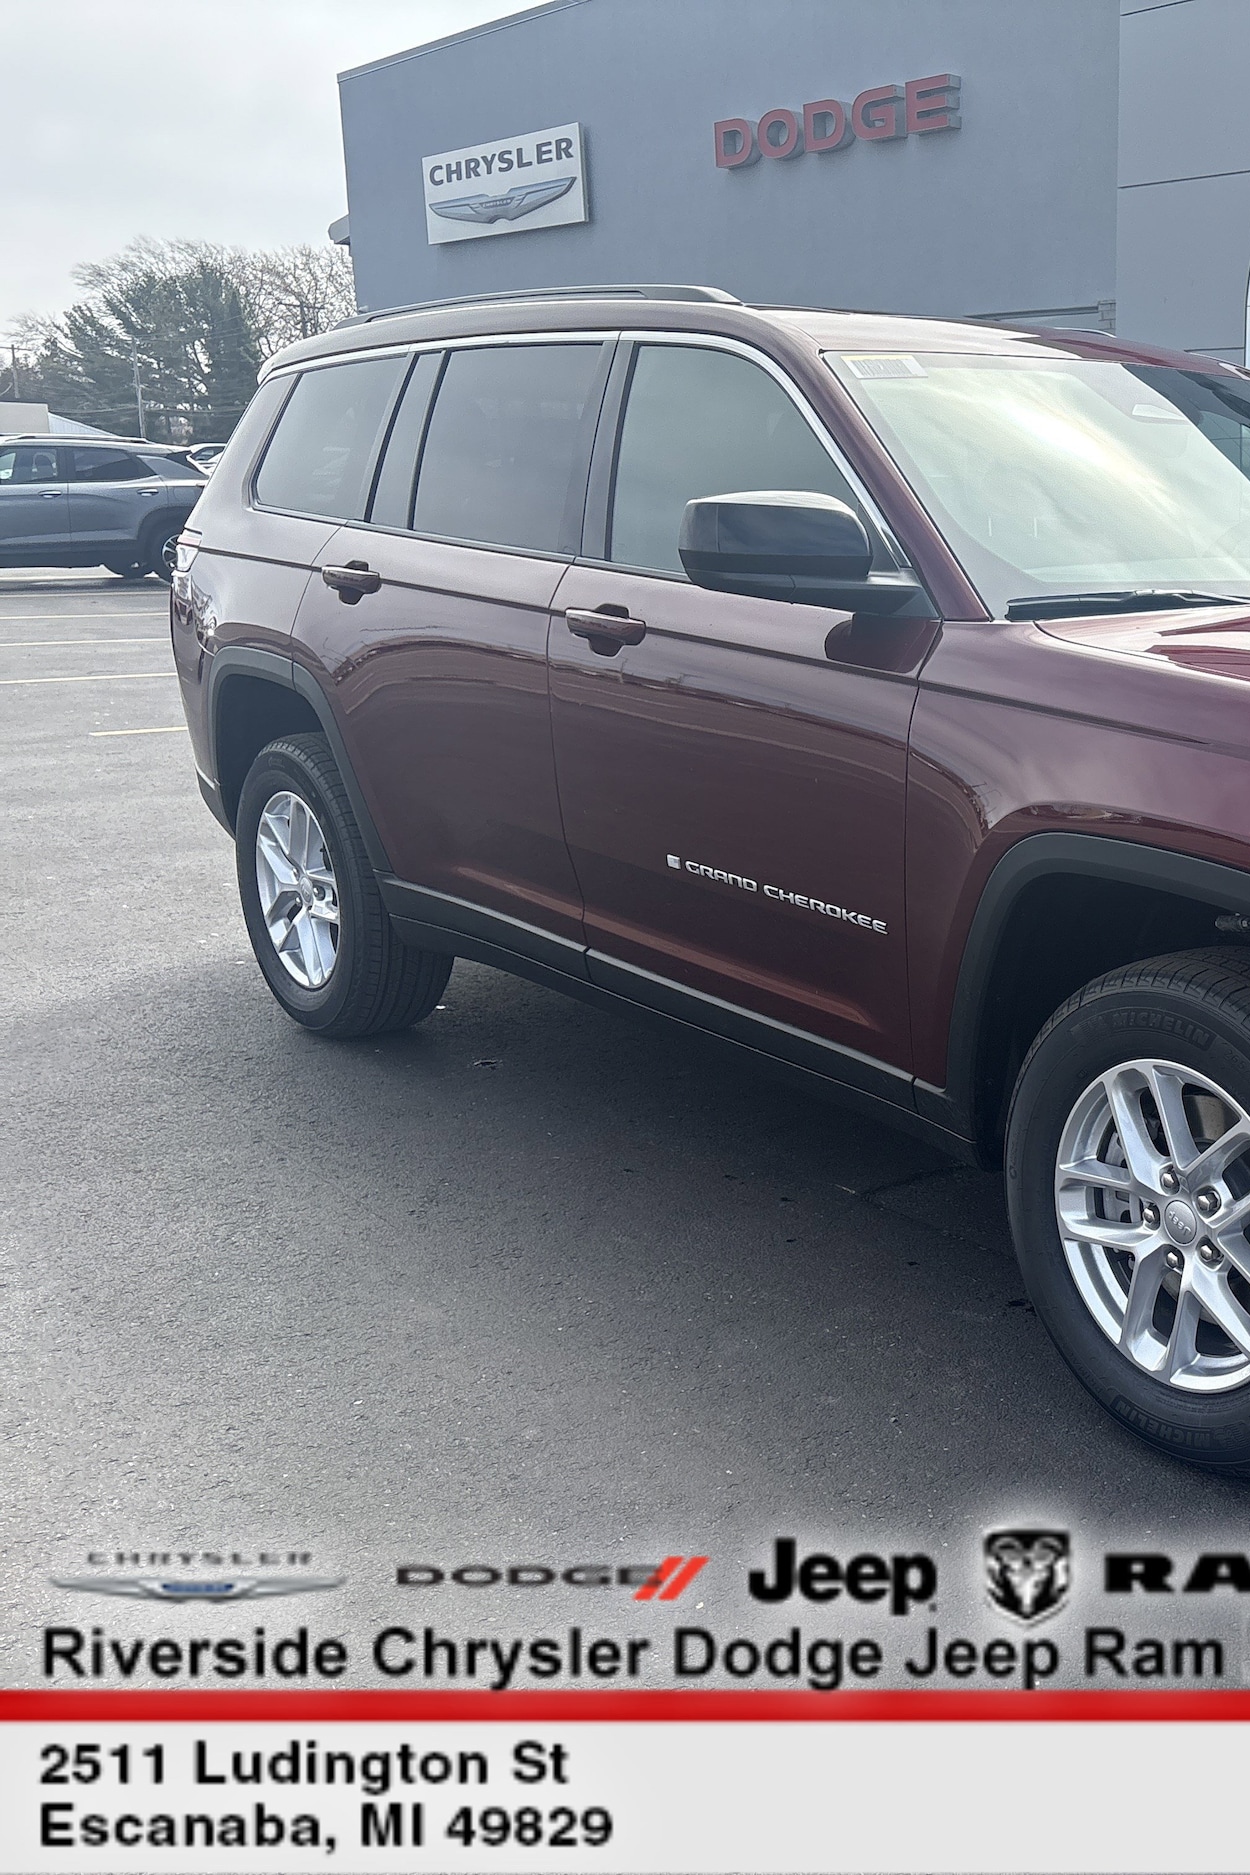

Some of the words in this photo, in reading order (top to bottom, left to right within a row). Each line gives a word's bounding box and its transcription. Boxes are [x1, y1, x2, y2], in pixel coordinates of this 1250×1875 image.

[713, 73, 962, 169] DODGE
[429, 137, 575, 187] CHRYSLER
[684, 860, 759, 893] GRAND
[762, 884, 889, 935] CHEROKEE
[1112, 1010, 1211, 1047] MICHELIN
[1161, 1204, 1192, 1236] Jeep
[1113, 1400, 1212, 1448] MICHELIN
